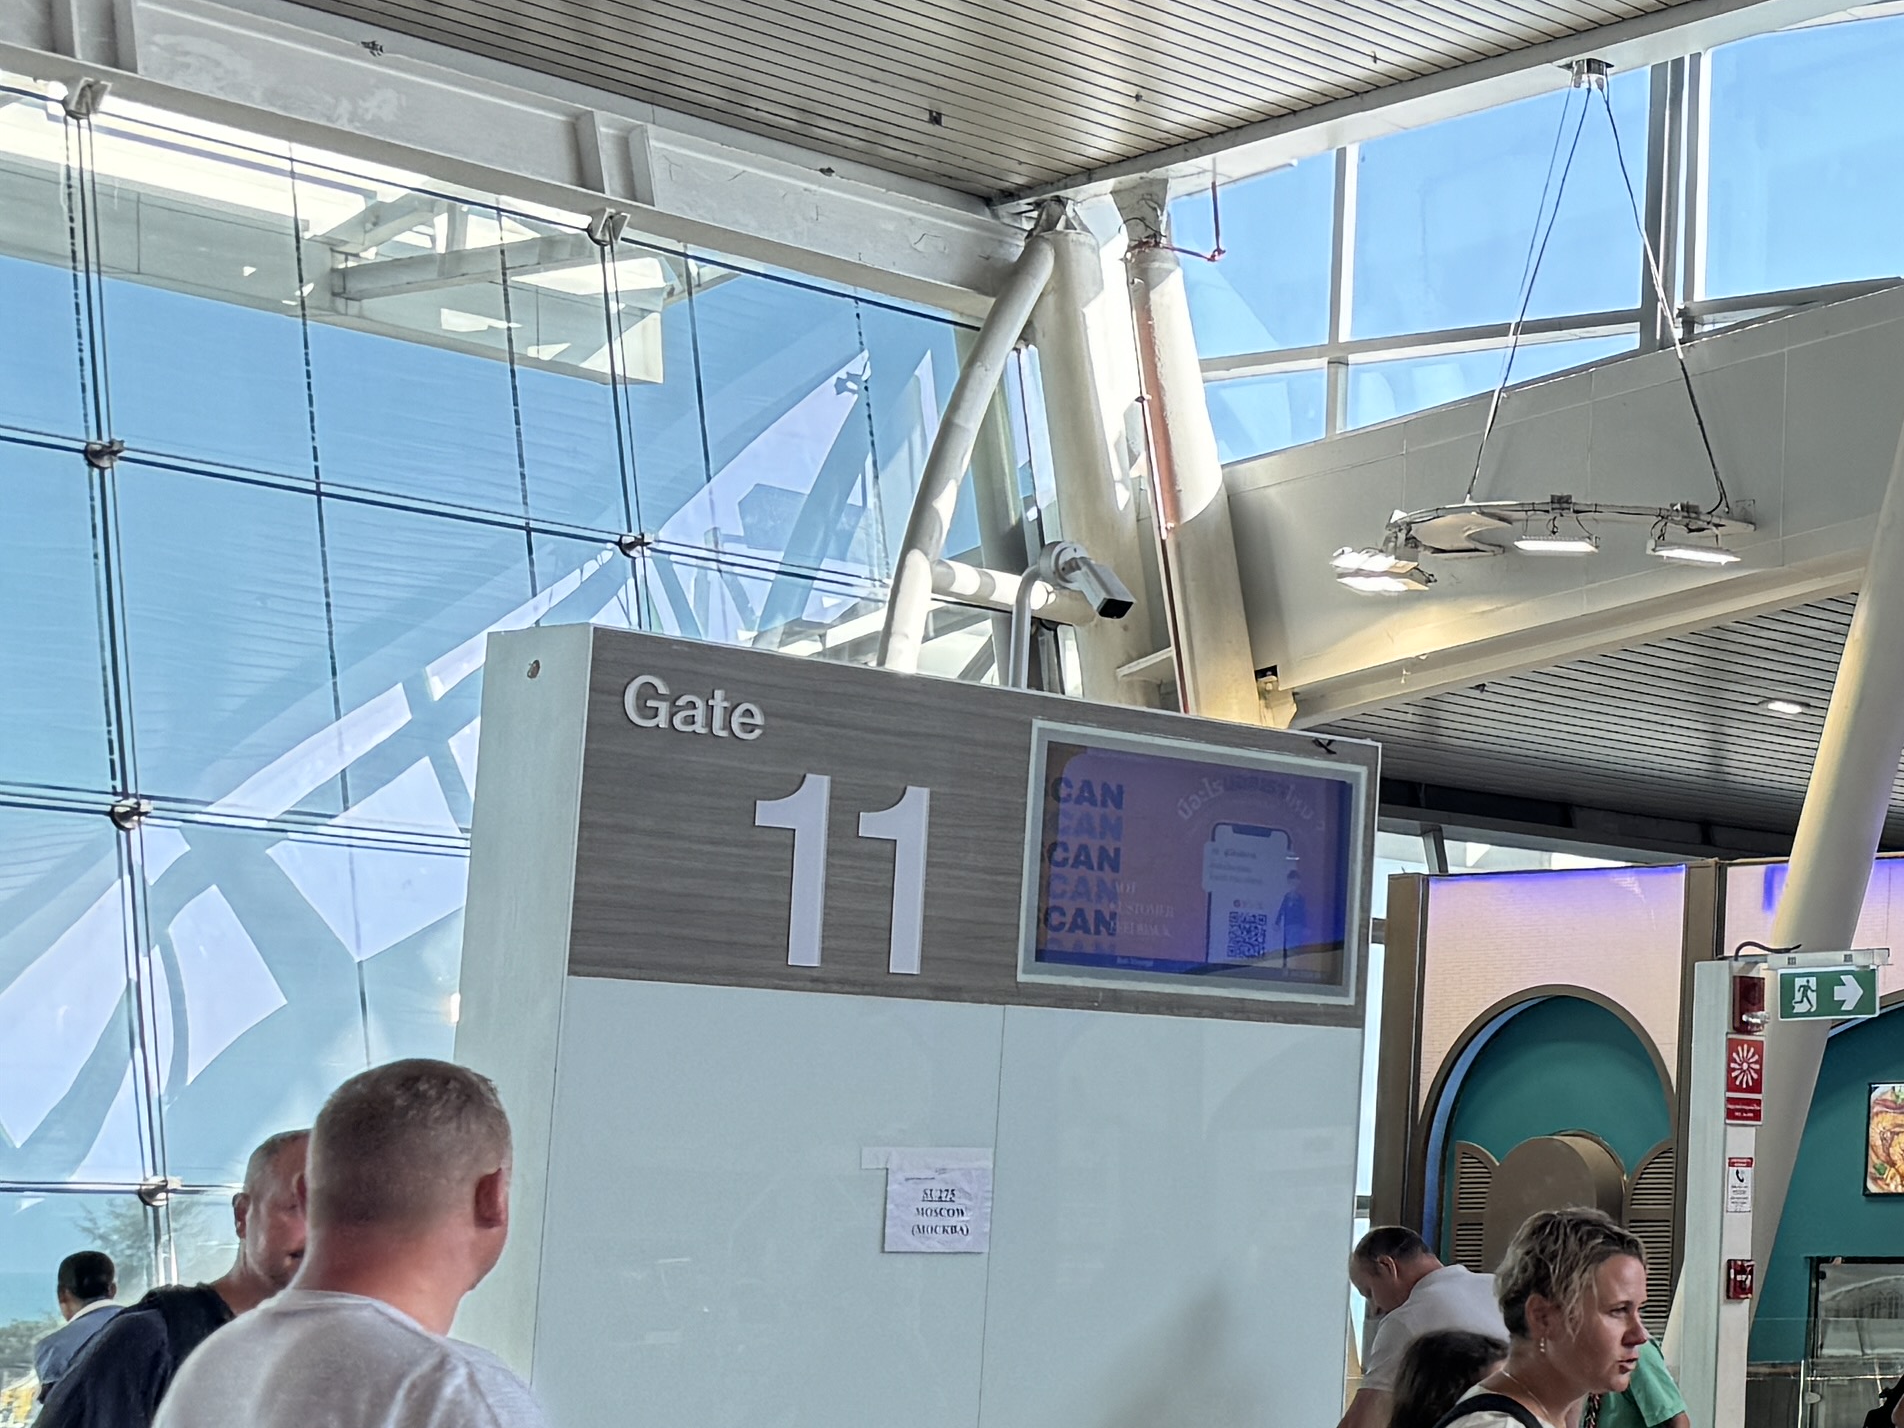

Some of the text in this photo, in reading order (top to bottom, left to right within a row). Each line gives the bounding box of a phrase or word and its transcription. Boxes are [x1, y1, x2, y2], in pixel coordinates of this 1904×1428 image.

[623, 675, 765, 741] Gate
[755, 775, 930, 974] 11
[916, 1207, 965, 1218] MOSCOW
